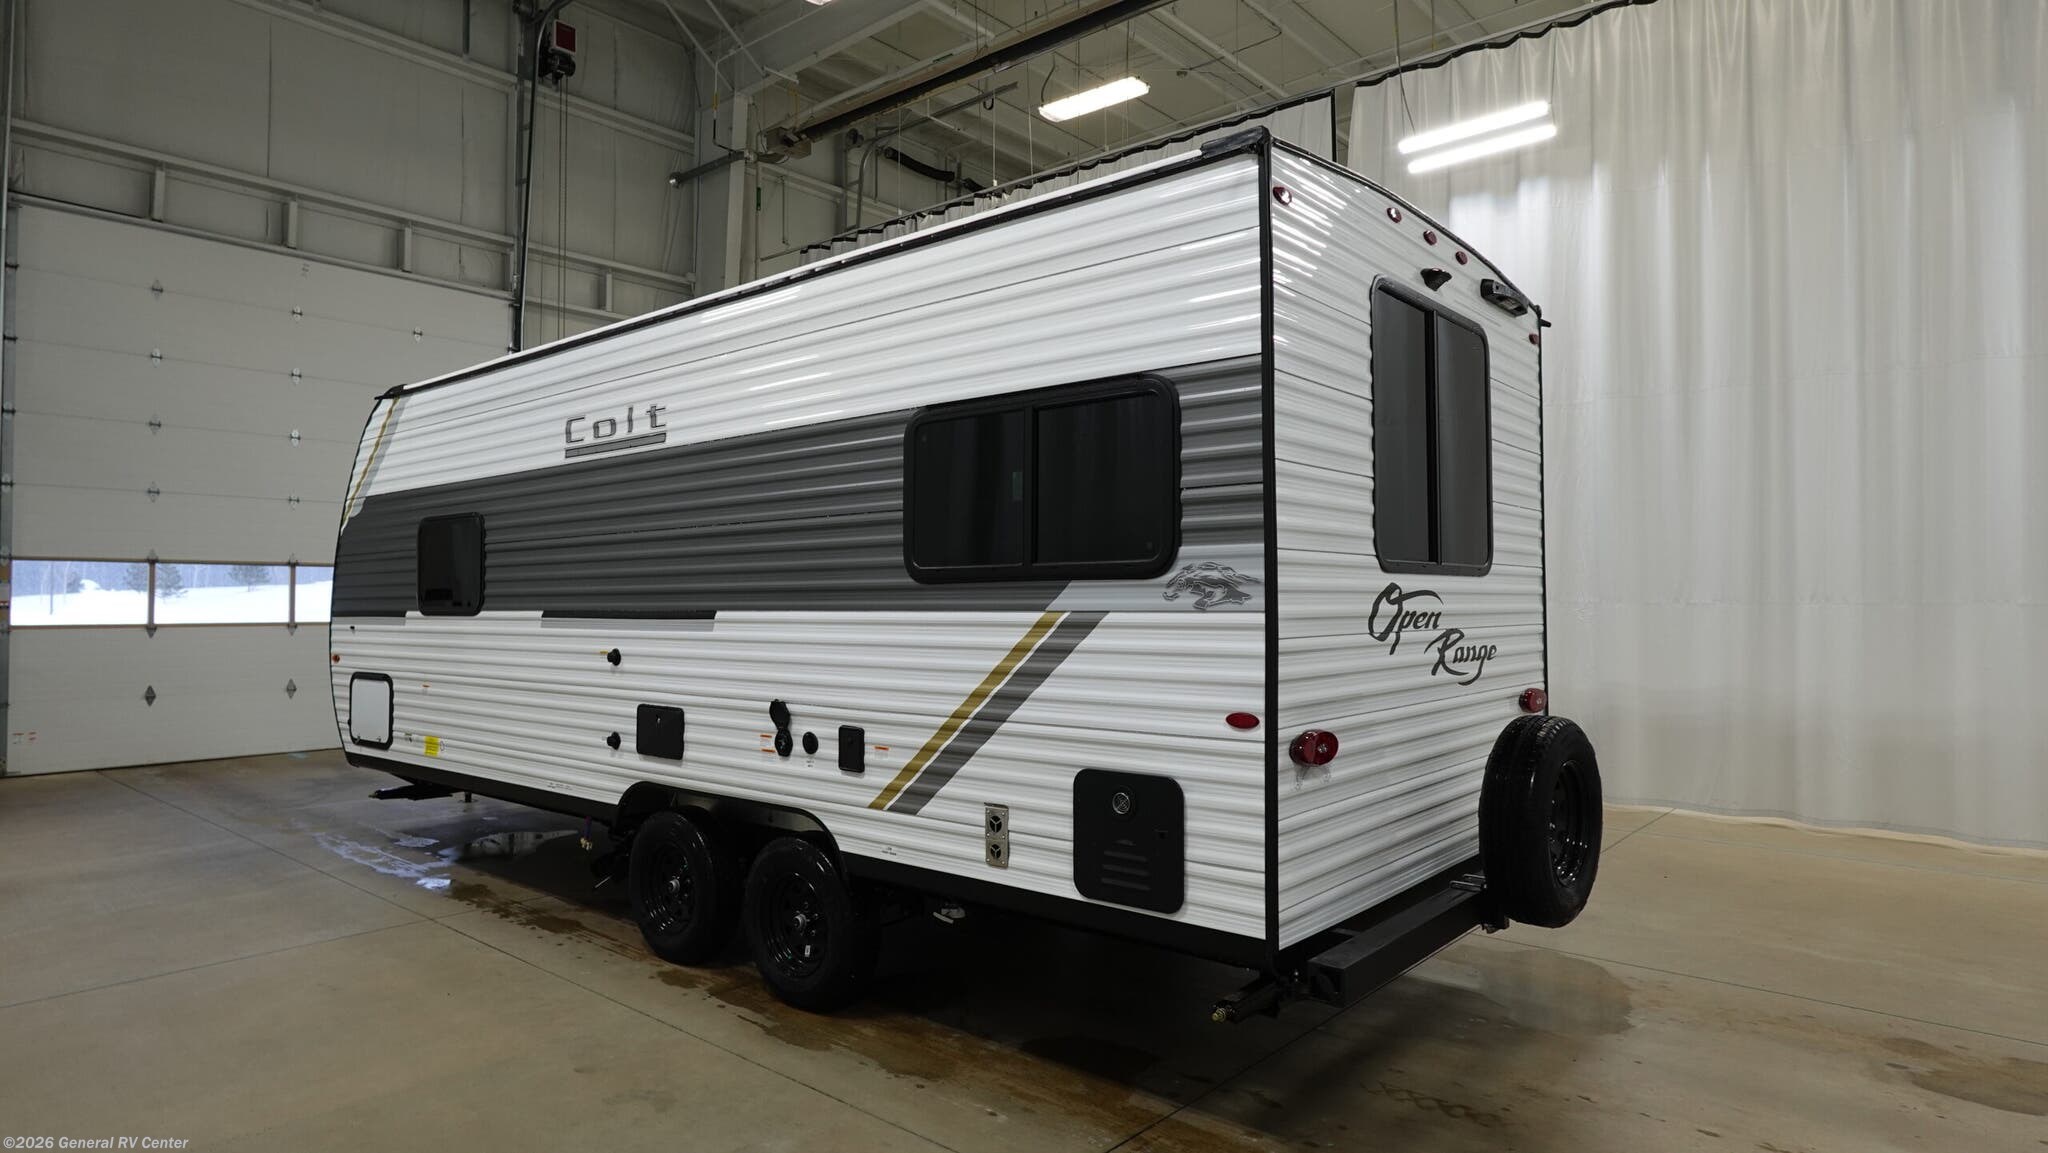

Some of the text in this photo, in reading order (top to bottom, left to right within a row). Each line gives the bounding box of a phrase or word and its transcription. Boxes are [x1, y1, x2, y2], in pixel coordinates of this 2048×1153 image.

[565, 405, 666, 443] Colt
[1368, 582, 1444, 655] Open
[1424, 628, 1497, 686] Range
